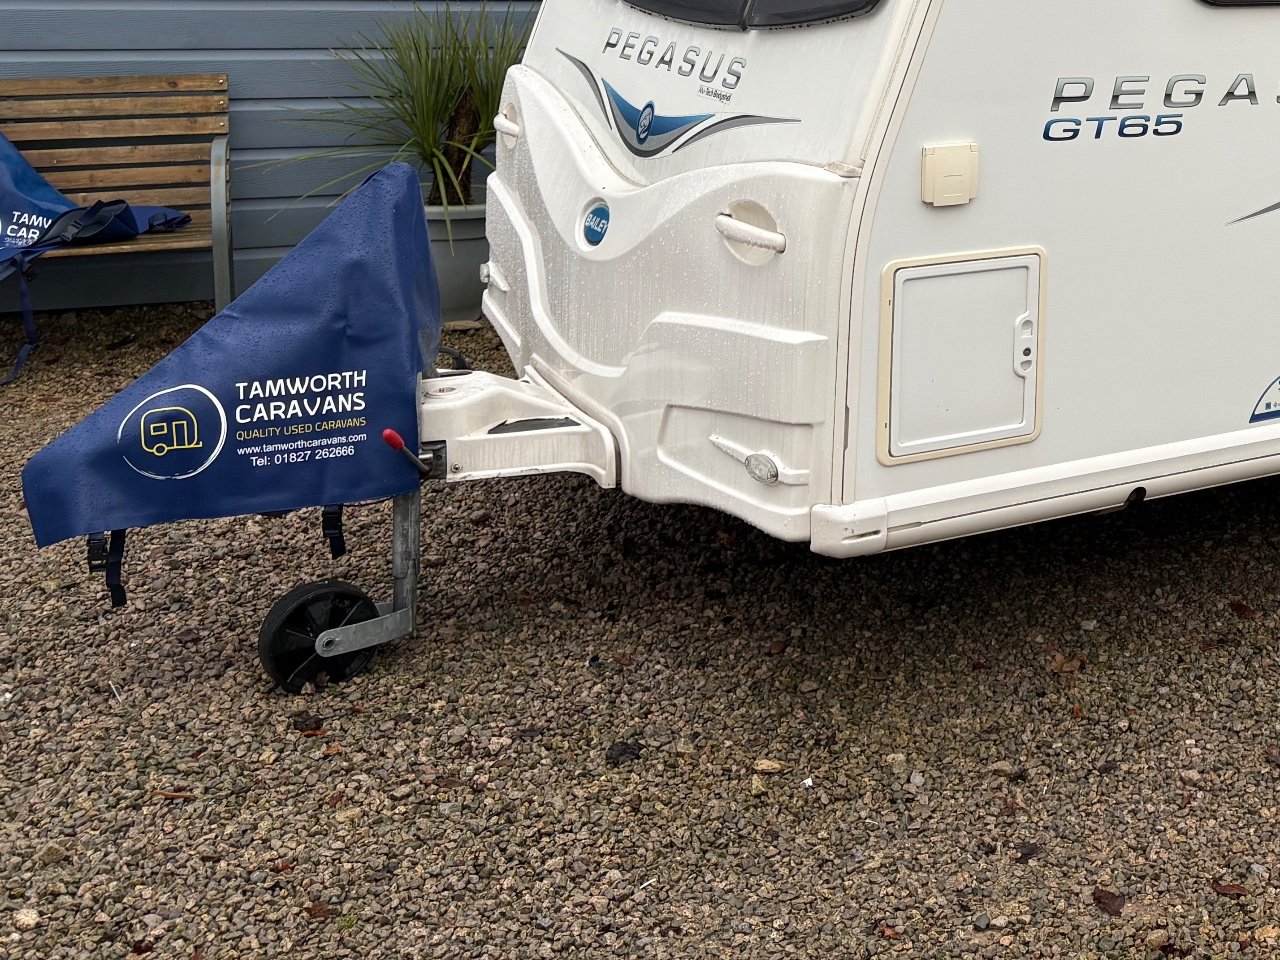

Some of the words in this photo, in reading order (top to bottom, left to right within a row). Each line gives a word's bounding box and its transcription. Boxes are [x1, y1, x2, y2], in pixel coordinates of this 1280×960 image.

[602, 27, 747, 90] PEGASUS
[1042, 113, 1184, 142] GT65
[585, 213, 609, 234] BAILEY
[235, 369, 367, 401] TAMWORTH
[235, 392, 366, 424] CARAVANS
[236, 426, 282, 441] QUALITY
[283, 423, 313, 436] USED
[315, 416, 367, 432] CARAVANS
[236, 433, 367, 456] www.tamworthcaravans.com
[249, 455, 271, 467] Tel:
[274, 451, 312, 465] 01827
[315, 445, 355, 460] 262666
